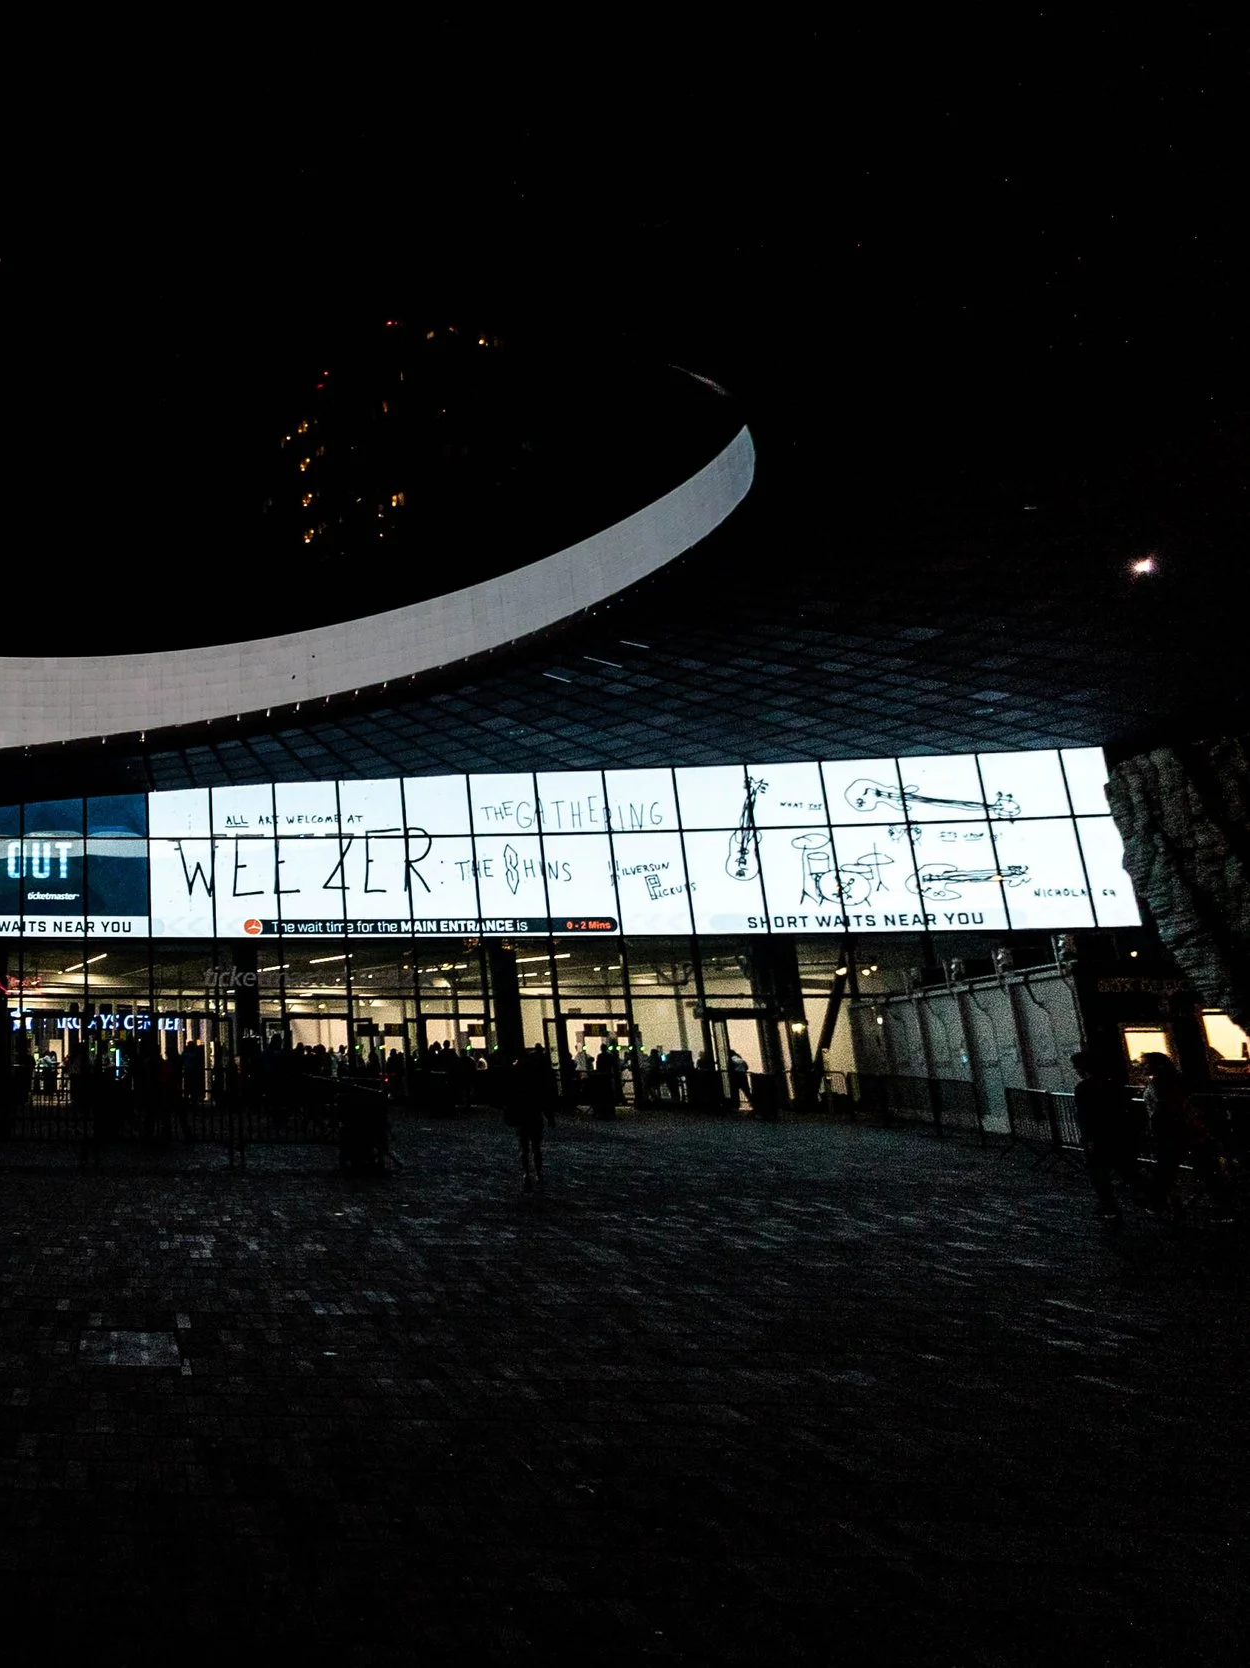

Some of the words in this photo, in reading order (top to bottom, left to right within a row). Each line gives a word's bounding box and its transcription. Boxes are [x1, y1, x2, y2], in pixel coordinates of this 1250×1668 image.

[481, 801, 514, 821] THE
[516, 795, 663, 831] GATHERING
[226, 815, 248, 825] ALL
[258, 815, 280, 825] ARE
[286, 814, 341, 824] WELCOME
[347, 814, 363, 823] AT
[7, 841, 72, 879] OUT
[455, 859, 494, 880] THE
[27, 891, 77, 901] ticketmaster
[1034, 888, 1092, 898] NICHOLA
[298, 921, 323, 933] wait
[326, 921, 354, 933] time
[357, 921, 375, 932] for
[378, 921, 398, 933] the
[401, 921, 437, 932] MAIN
[440, 920, 514, 932] ENTRANCE
[517, 920, 528, 931] is
[588, 920, 612, 930] Mins
[747, 916, 808, 929] SHORT
[884, 913, 937, 926] NEAR
[944, 912, 985, 925] YOU
[53, 921, 95, 933] NEAR
[101, 921, 132, 933] YOU
